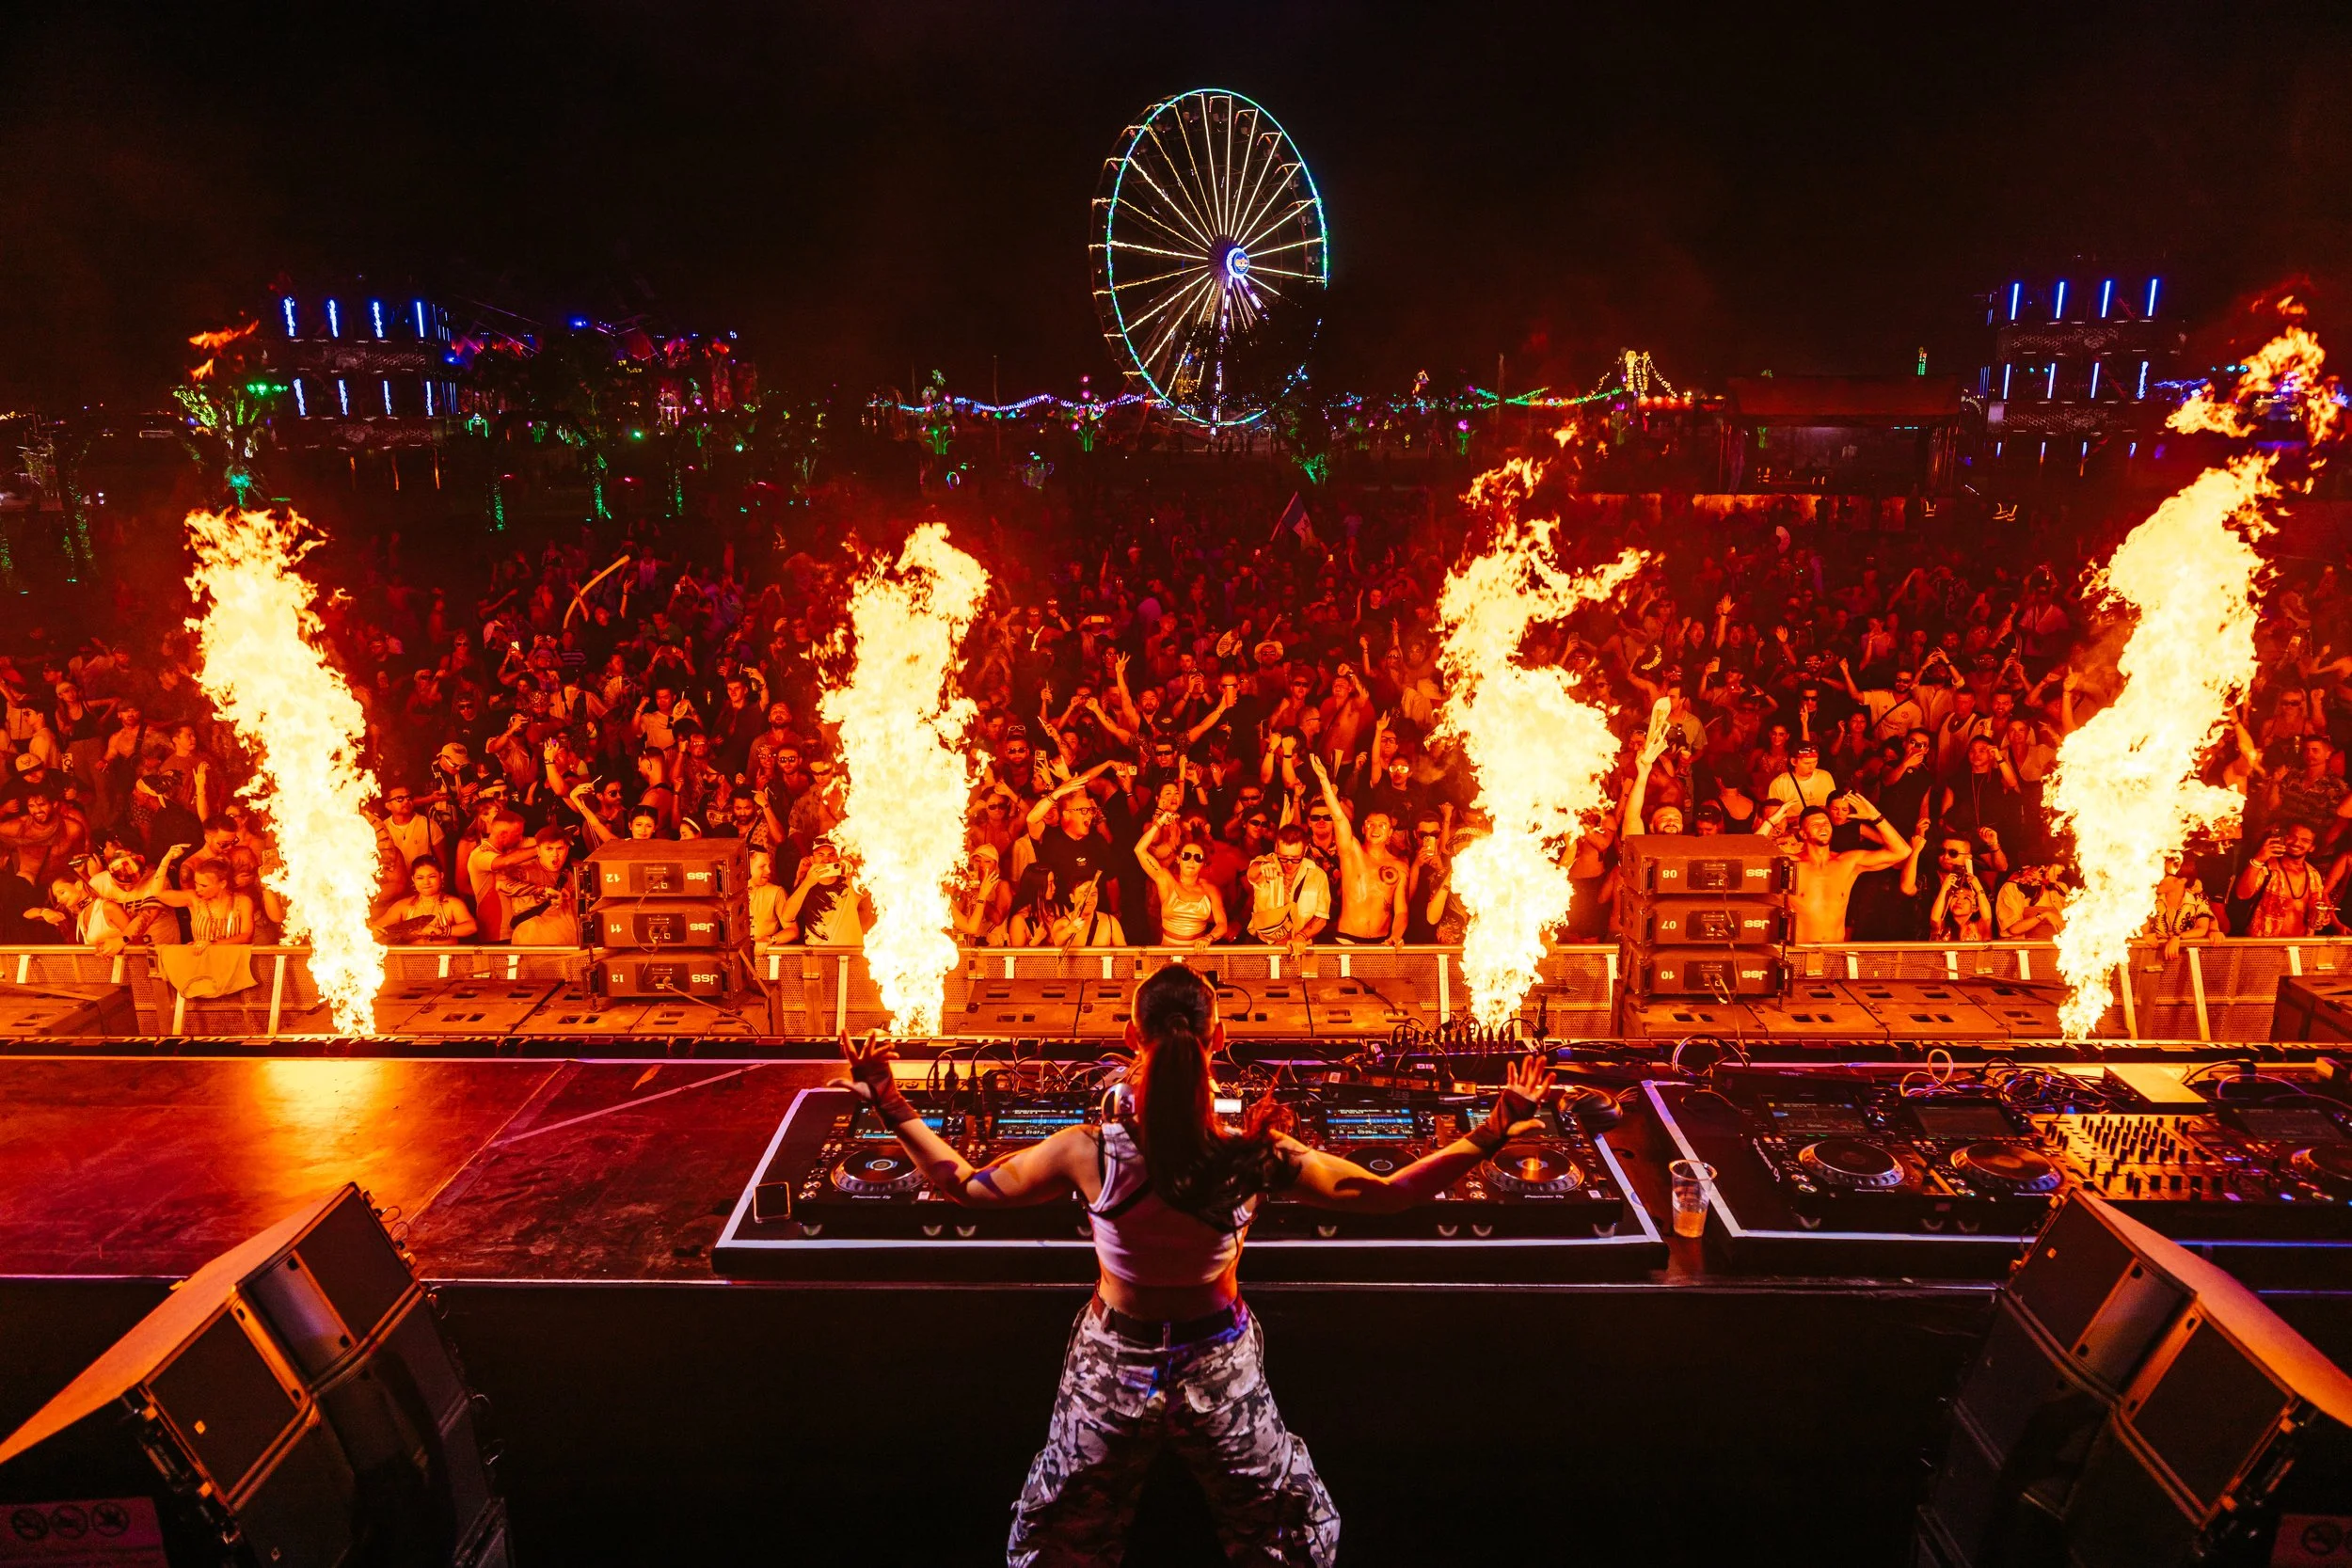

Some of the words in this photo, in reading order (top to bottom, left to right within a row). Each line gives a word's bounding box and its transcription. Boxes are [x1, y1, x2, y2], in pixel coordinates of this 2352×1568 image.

[605, 873, 621, 882] 12
[686, 871, 712, 882] jss
[1661, 869, 1677, 879] 08
[1745, 868, 1772, 879] jss
[610, 924, 623, 933] 11
[689, 923, 715, 933] jss
[1661, 920, 1677, 929] 07
[1743, 919, 1771, 930] jss
[612, 974, 624, 983] 13
[691, 974, 719, 985] jss
[1661, 970, 1676, 979] 10
[1741, 970, 1769, 981] jss
